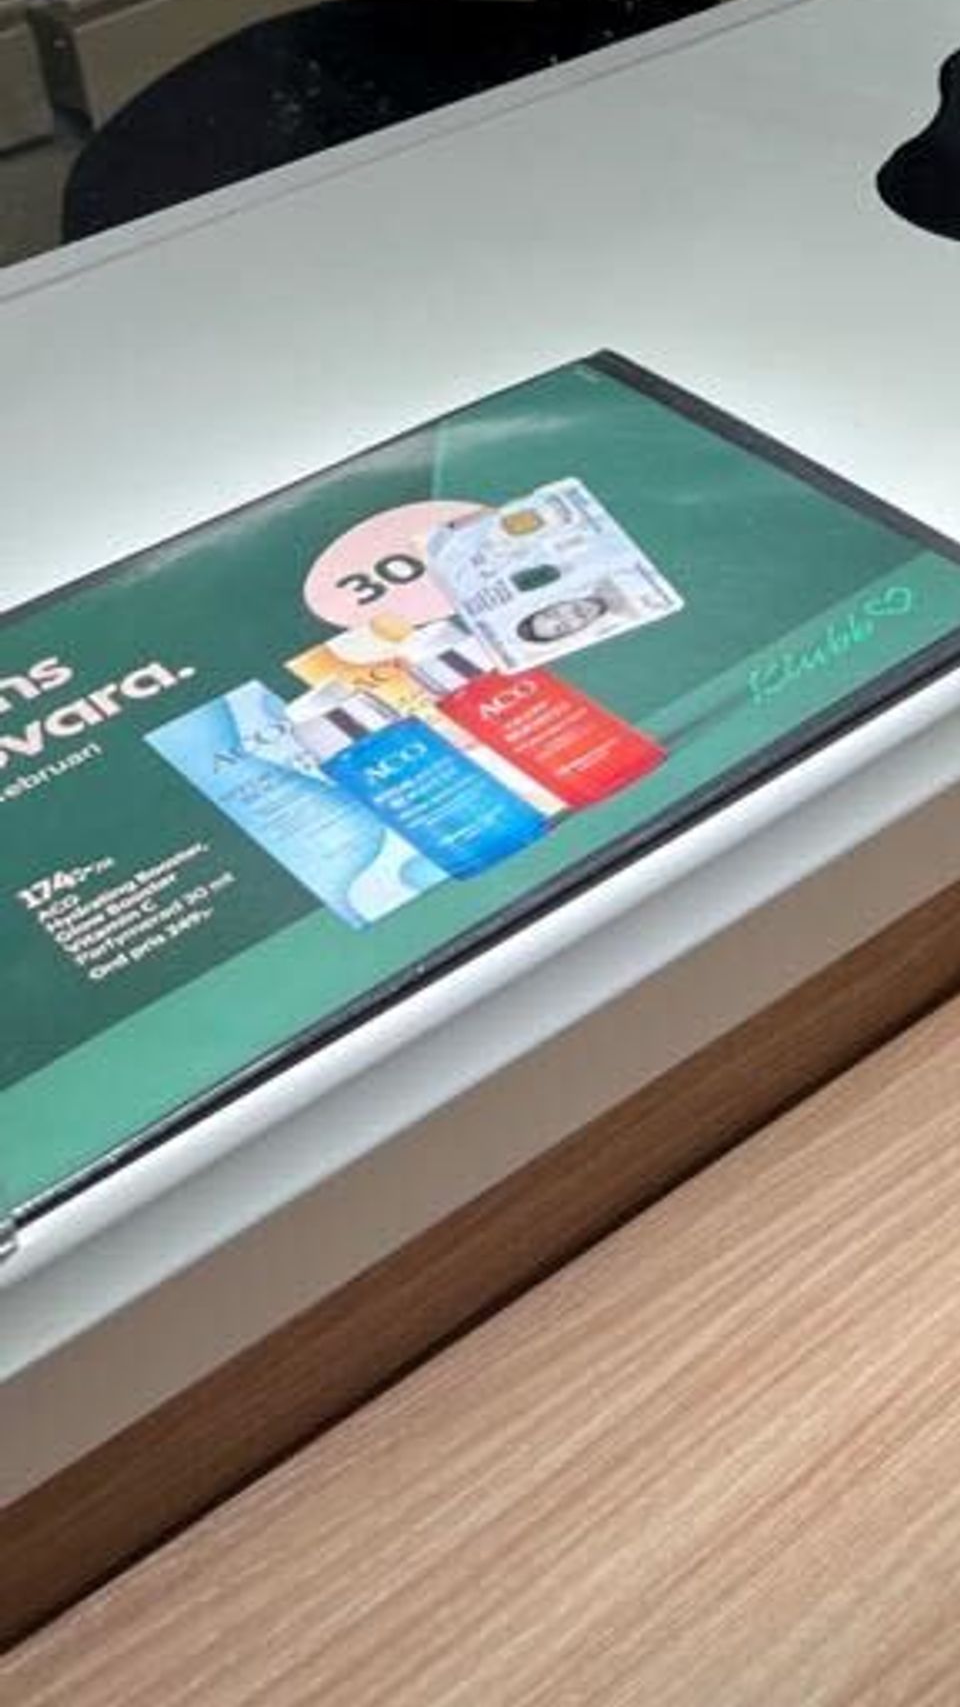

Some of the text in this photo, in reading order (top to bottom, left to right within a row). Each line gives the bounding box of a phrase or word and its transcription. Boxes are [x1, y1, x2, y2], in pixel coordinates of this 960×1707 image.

[336, 553, 426, 606] 30
[0, 661, 197, 769] vara.
[0, 741, 103, 803] ebruari
